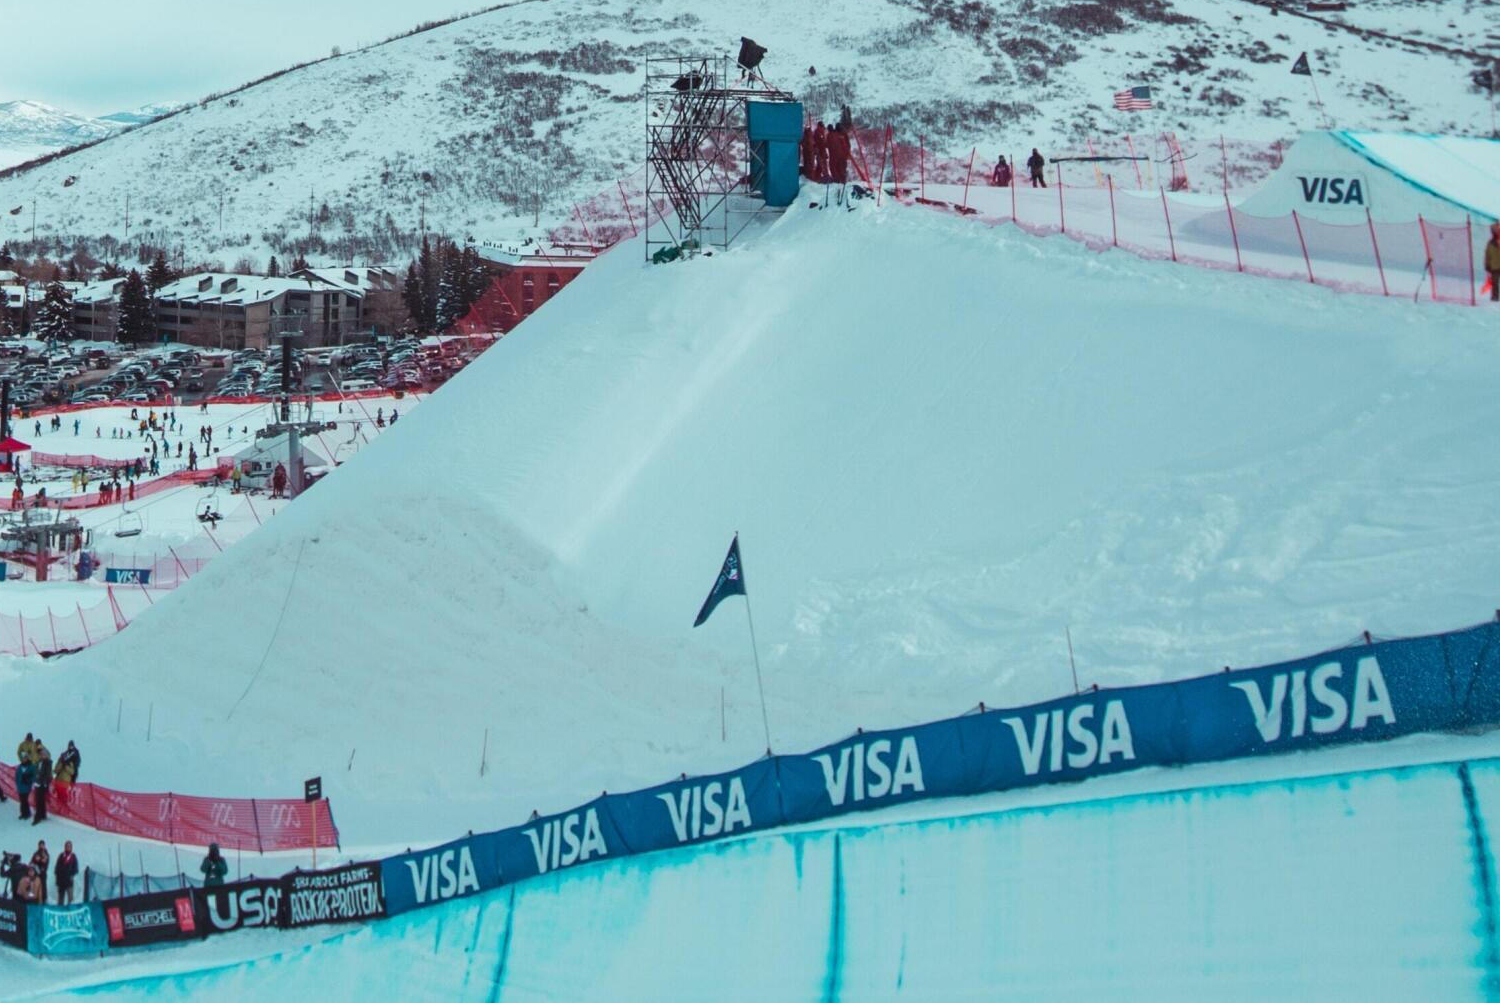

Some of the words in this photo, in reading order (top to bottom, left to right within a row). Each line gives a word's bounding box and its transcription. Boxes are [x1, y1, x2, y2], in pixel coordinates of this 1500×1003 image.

[1296, 176, 1364, 205] VISA
[1230, 655, 1396, 742] VISA
[811, 736, 926, 806] VISA
[1002, 700, 1136, 776] VISA
[522, 807, 608, 874] VISA
[656, 777, 753, 843] VISA
[404, 846, 481, 905] VISA
